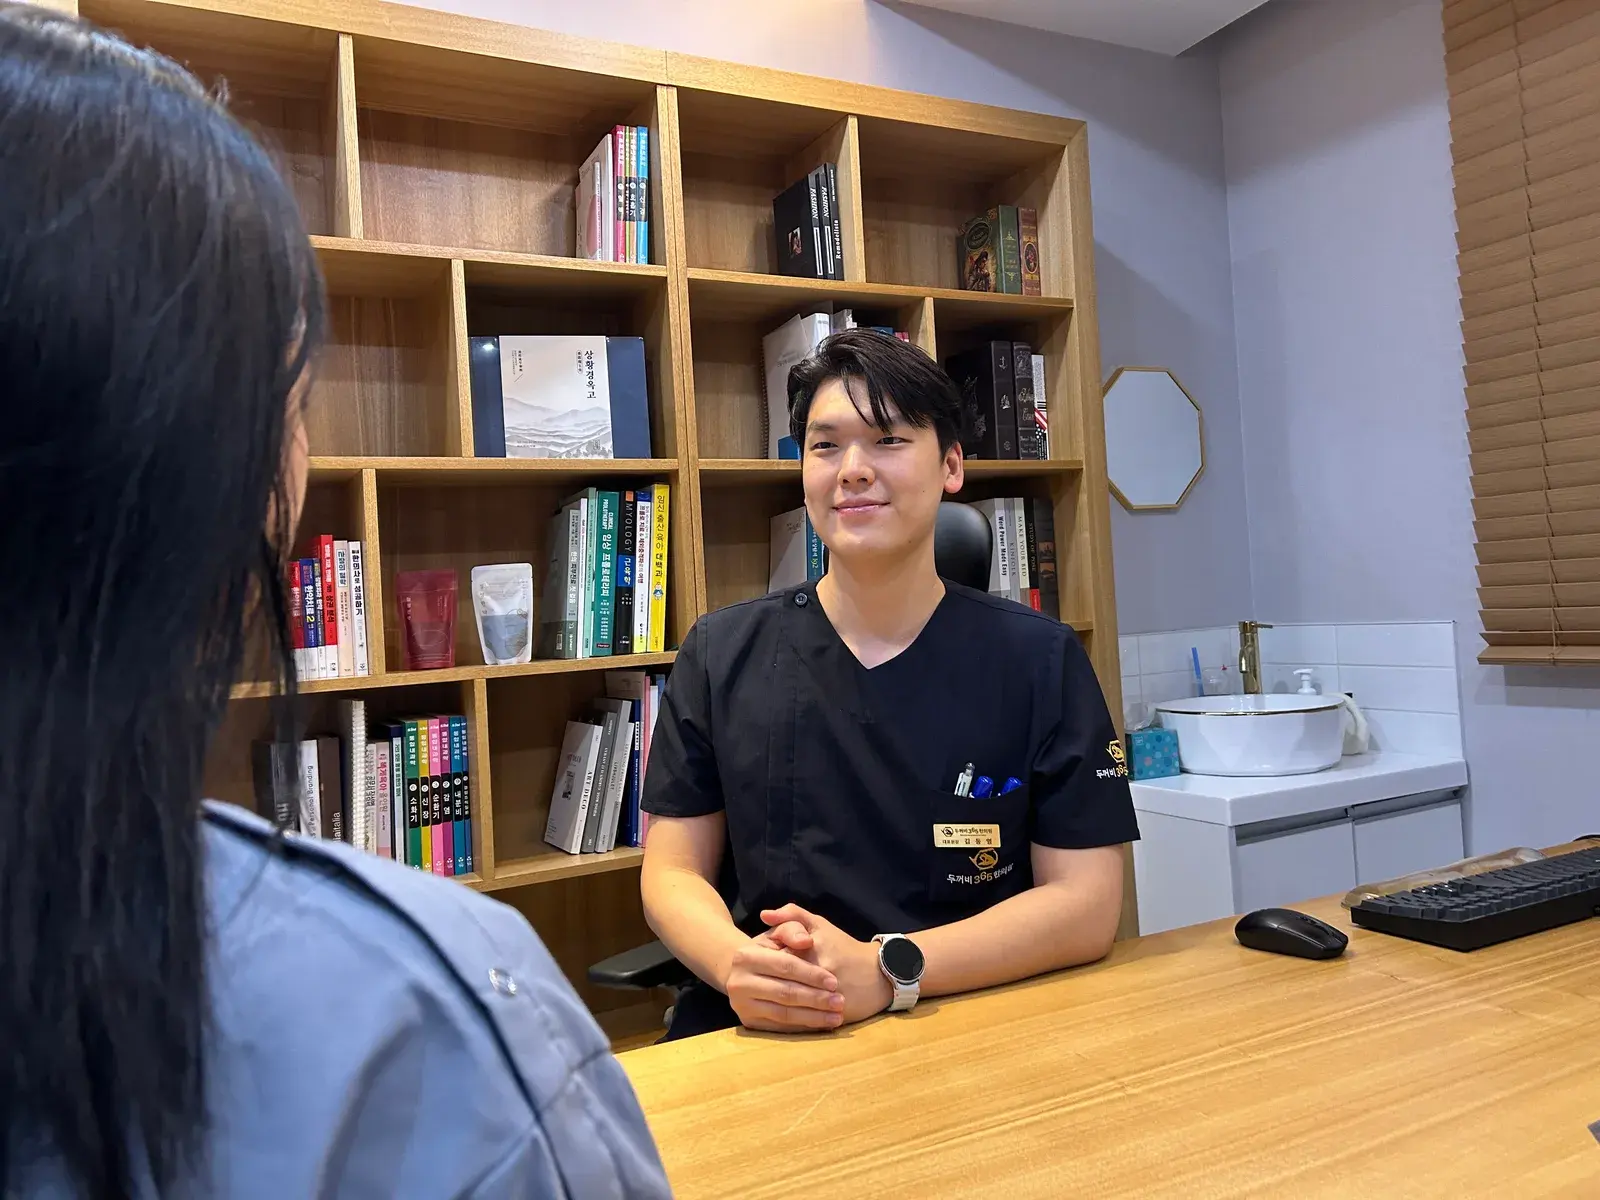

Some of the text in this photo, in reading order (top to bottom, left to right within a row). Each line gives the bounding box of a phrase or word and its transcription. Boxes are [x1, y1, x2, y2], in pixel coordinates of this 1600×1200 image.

[810, 187, 819, 219] FASHION
[821, 186, 829, 218] FASHION
[584, 350, 597, 399] 상황경옥고
[602, 533, 612, 551] 임상
[624, 503, 633, 552] MYOLOGY
[655, 495, 665, 577] 임신 출산 육아 대백과
[306, 765, 314, 794] Branding
[432, 793, 440, 819] 순환기
[454, 790, 462, 816] 내분비
[581, 789, 590, 810] DECO
